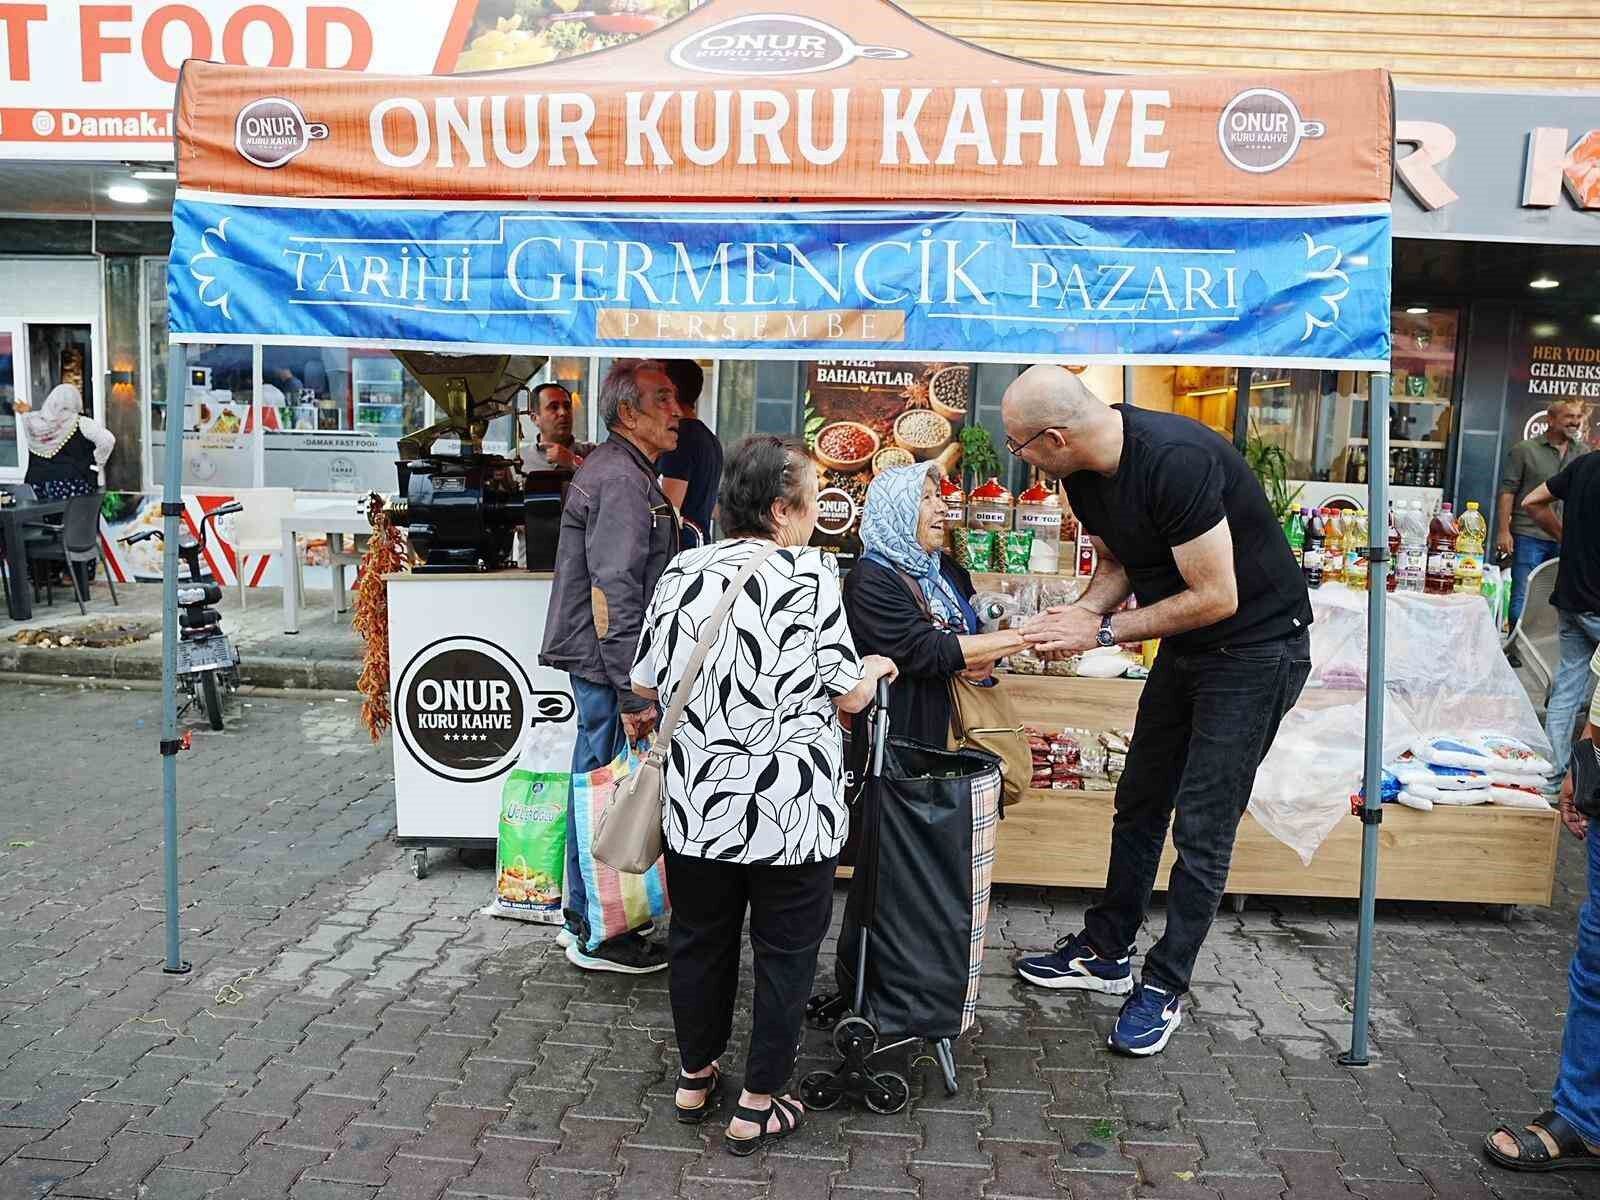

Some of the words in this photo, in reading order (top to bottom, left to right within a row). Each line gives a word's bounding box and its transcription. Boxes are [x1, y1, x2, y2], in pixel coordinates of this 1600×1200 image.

[80, 4, 374, 83] FOOD
[700, 34, 827, 51] ONUR
[696, 48, 749, 58] KURU
[755, 49, 825, 58] KAHVE
[246, 117, 297, 138] ONUR
[368, 92, 598, 169] ONUR
[624, 89, 851, 167] KURU
[880, 88, 1171, 168] KAHVE
[1231, 111, 1289, 132] ONUR
[1231, 132, 1255, 143] KURU
[1258, 133, 1288, 144] KAHVE
[283, 247, 473, 302] TARİHİ
[506, 227, 995, 306] GERMENCİK
[1029, 262, 1239, 312] PAZARI
[1532, 345, 1562, 360] HER
[816, 367, 914, 386] BAHARATLAR
[1528, 378, 1578, 396] KAHVE
[1531, 422, 1549, 435] ON
[818, 500, 849, 513] ONUR
[416, 678, 512, 712] ONUR
[418, 713, 458, 730] KURU
[461, 713, 512, 730] KAHVE
